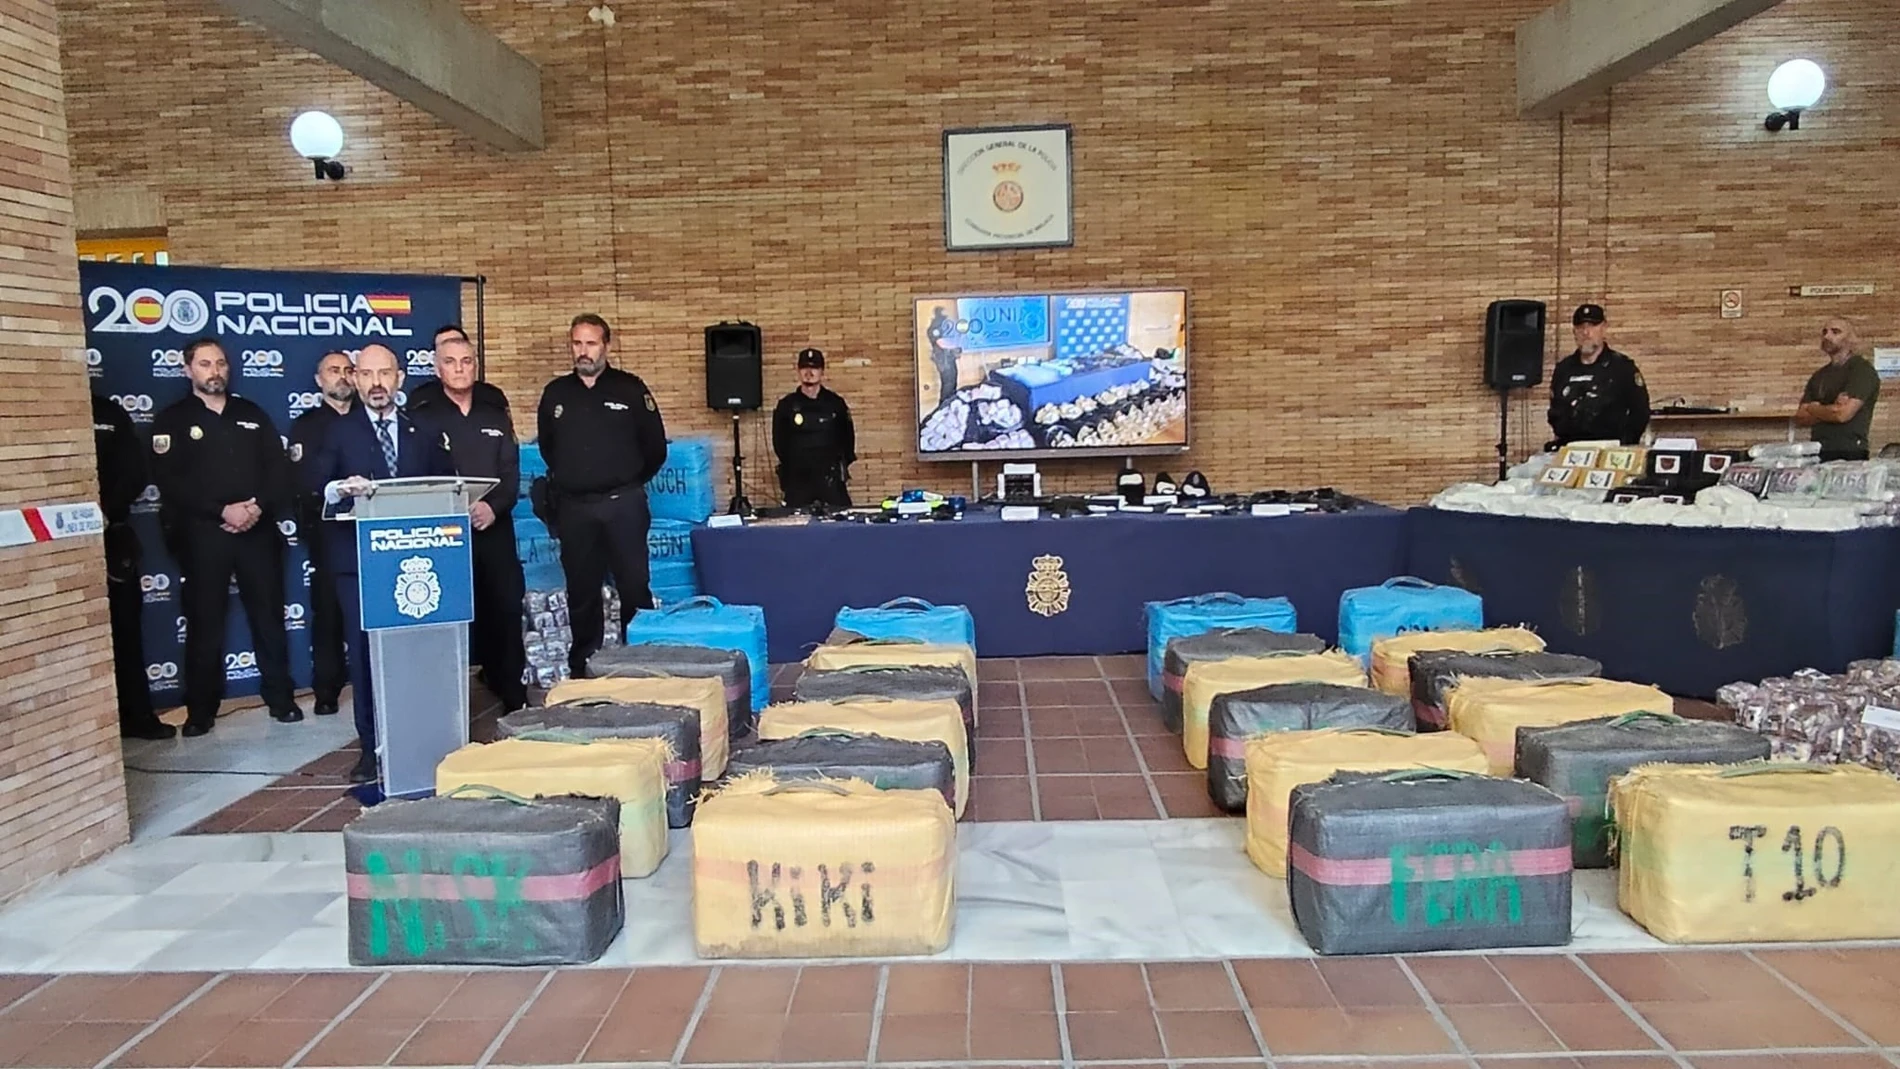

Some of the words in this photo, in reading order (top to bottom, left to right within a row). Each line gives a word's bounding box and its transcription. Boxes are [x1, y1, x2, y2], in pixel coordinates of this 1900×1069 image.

[88, 286, 209, 334] 200
[214, 291, 374, 314] POLICIA
[216, 315, 413, 336] NACIONAL
[241, 350, 283, 366] 200
[370, 526, 444, 541] POLICIA
[371, 537, 464, 551] NACIONAL
